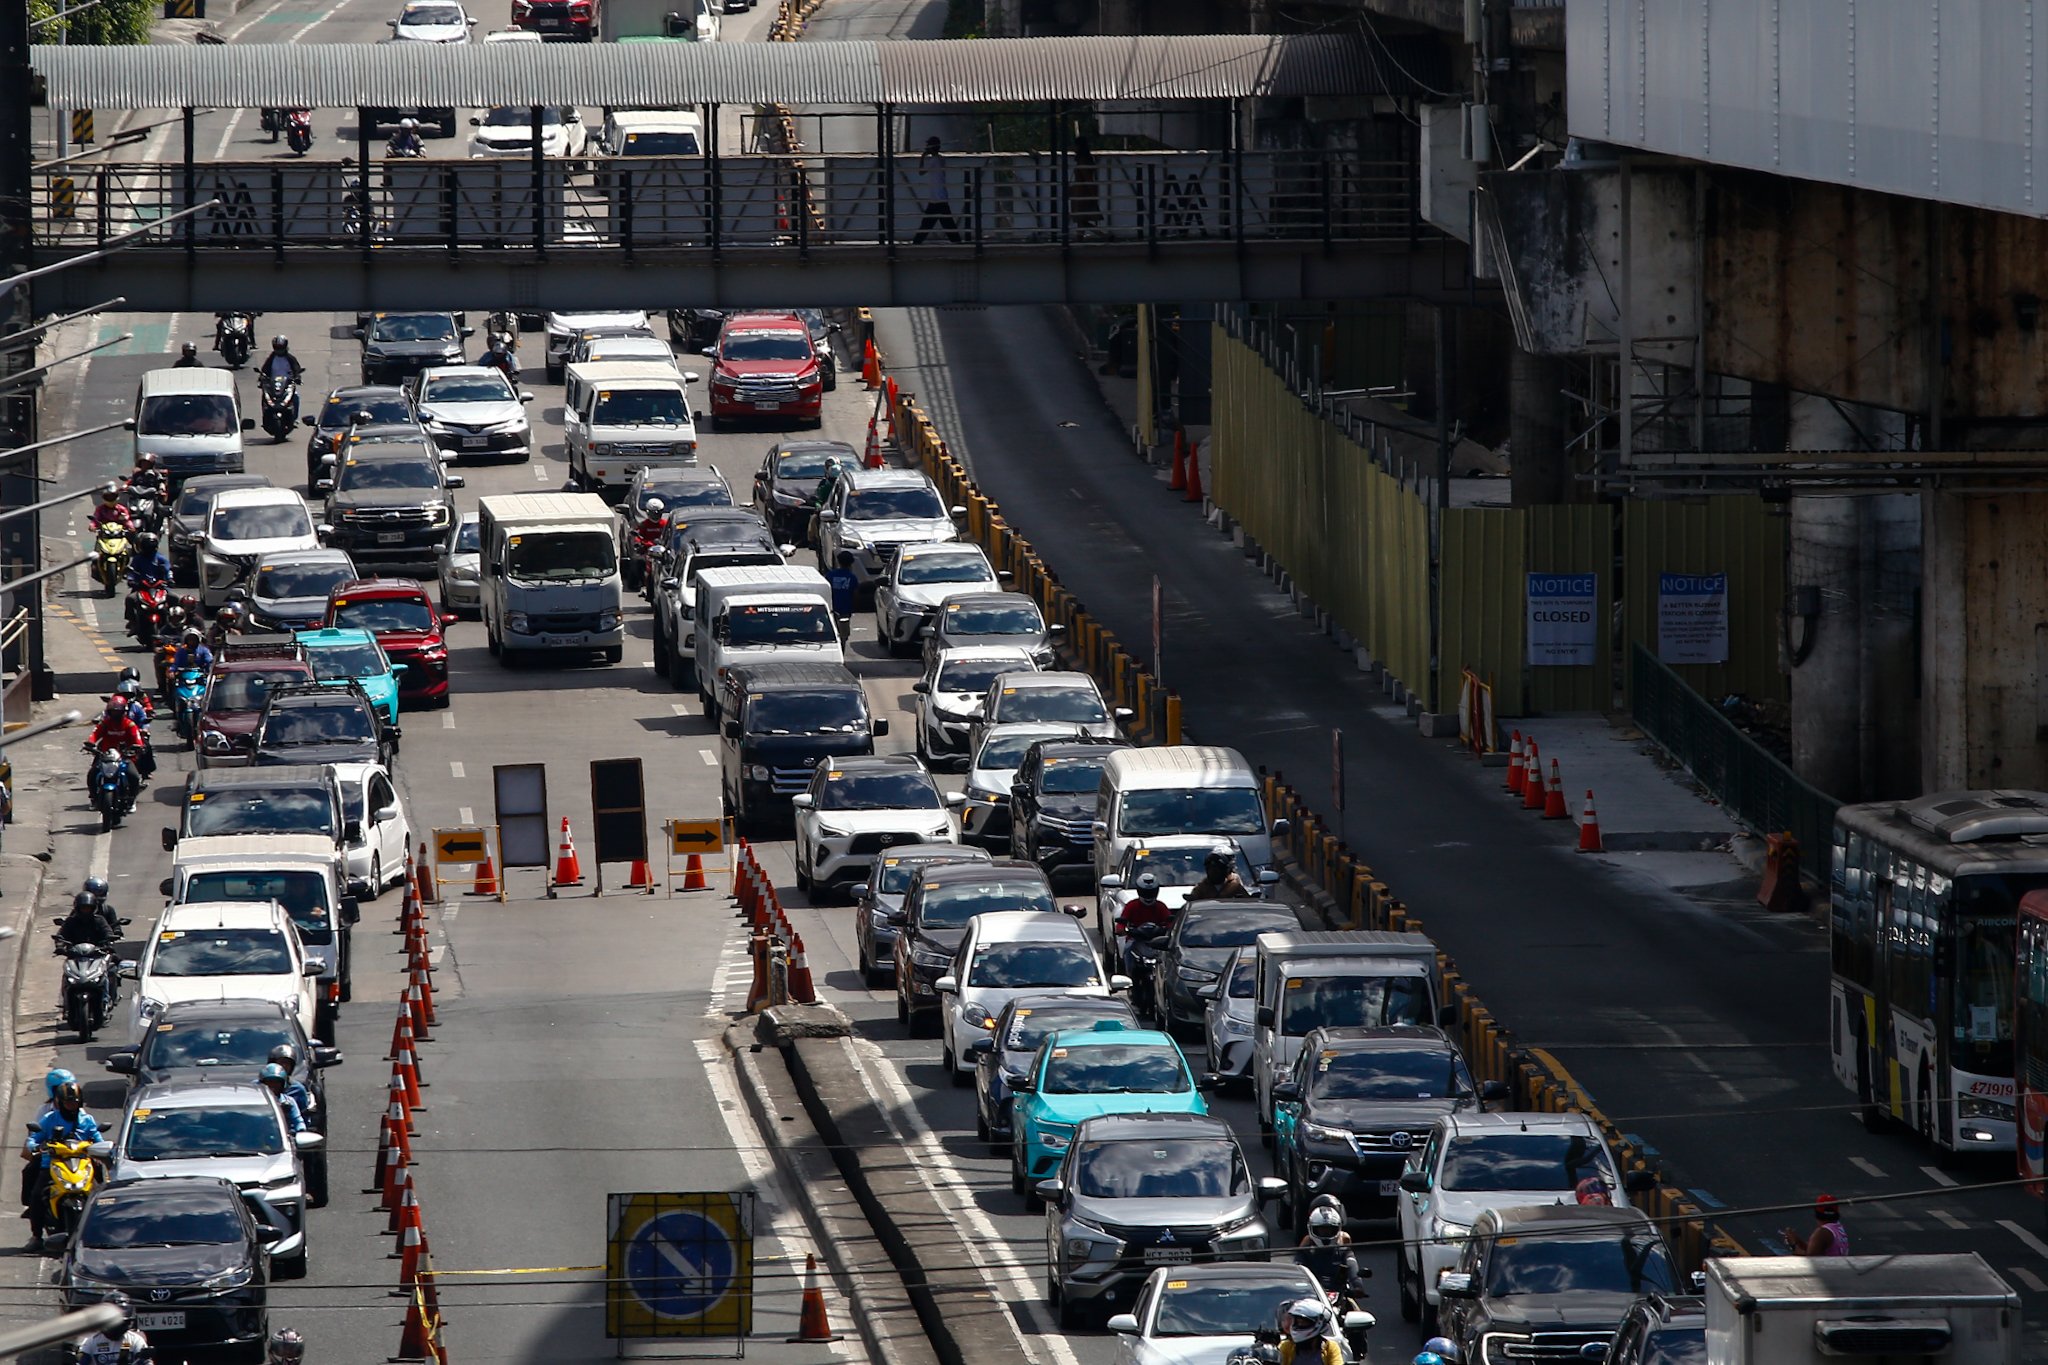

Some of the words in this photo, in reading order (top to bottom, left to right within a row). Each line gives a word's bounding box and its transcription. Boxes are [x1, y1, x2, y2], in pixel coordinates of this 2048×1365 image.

[1531, 579, 1593, 593] NOTICE
[1661, 577, 1723, 592] NOTICE
[1533, 610, 1591, 623] CLOSED
[1976, 917, 2017, 926] AIRCON
[1969, 1081, 2015, 1097] 471919
